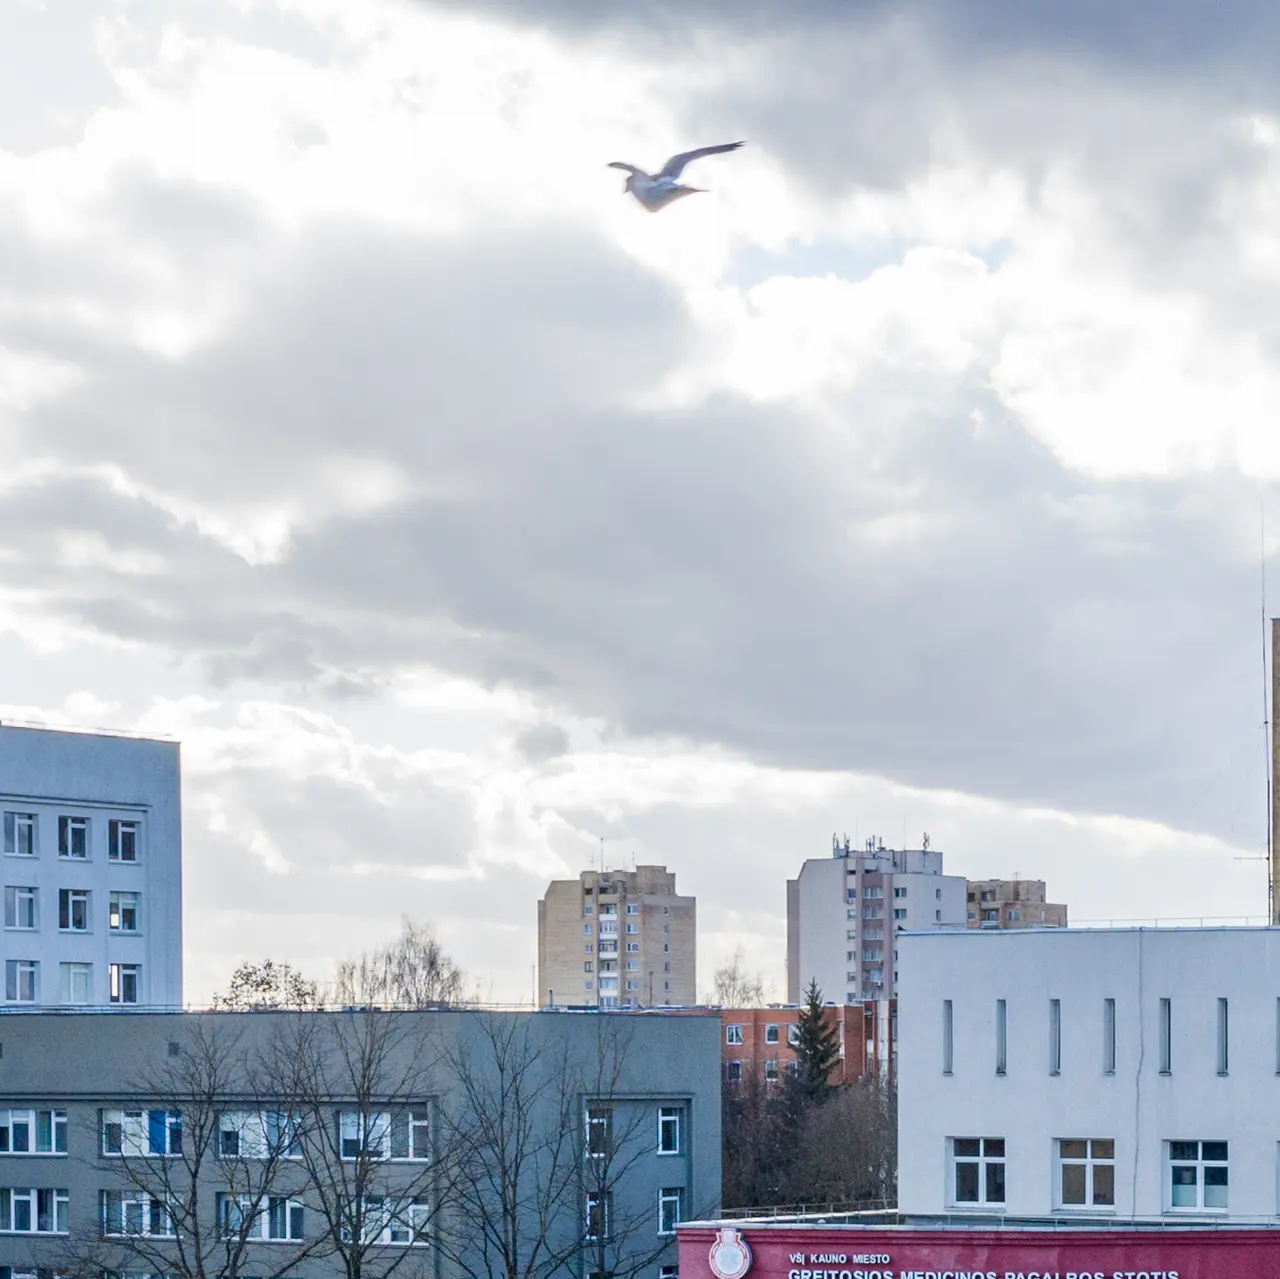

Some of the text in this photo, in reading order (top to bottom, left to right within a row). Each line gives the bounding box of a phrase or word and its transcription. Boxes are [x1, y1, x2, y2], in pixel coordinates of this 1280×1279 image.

[789, 1252, 890, 1265] VŠĮ KAUNO MIESTO
